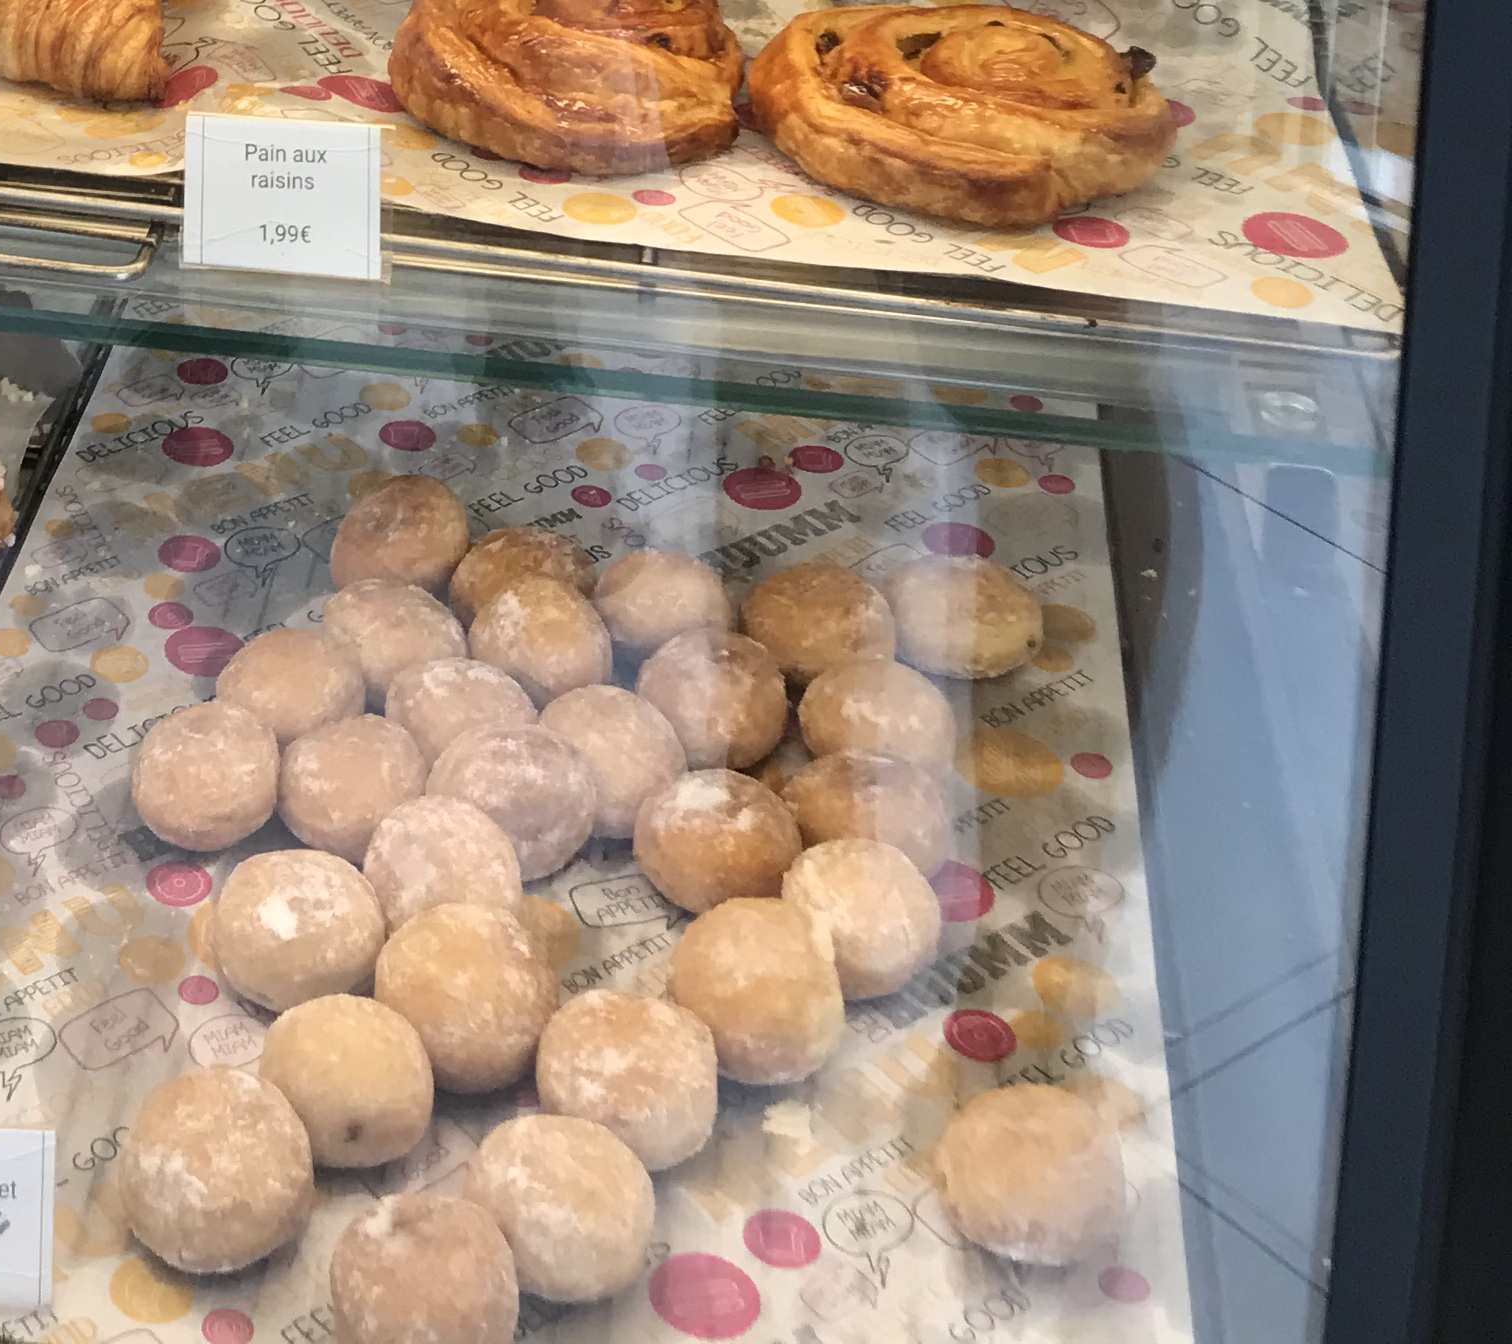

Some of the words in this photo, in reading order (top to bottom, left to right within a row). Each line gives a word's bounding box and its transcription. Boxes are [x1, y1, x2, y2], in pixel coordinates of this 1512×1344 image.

[298, 33, 353, 75] FEEL
[1249, 35, 1313, 89] FEEL
[245, 143, 287, 162] Pain
[293, 149, 328, 164] aux
[430, 152, 504, 191] GOOD
[251, 171, 315, 190] raisins
[1190, 166, 1255, 196] FEEL
[508, 190, 566, 223] FEEL
[851, 202, 935, 245] GOOD
[258, 224, 312, 245] 1,99€
[943, 243, 1008, 274] FEEL
[1208, 229, 1406, 323] DELICIOUS
[75, 410, 204, 464] DELICIOUS
[259, 424, 311, 448] FEEL
[311, 402, 372, 430] GOOD
[468, 490, 525, 518] FEEL
[524, 465, 588, 494] GOOD
[616, 456, 739, 512] DELICIOUS
[211, 515, 248, 535] BON
[250, 493, 315, 522] APPETIT
[884, 510, 932, 533] FEEL
[26, 674, 97, 709] GOOD
[980, 703, 1025, 729] BON
[1021, 669, 1094, 711] APPETIT
[981, 855, 1048, 891] FEEL
[1042, 815, 1116, 859] GOOD
[13, 880, 56, 907] BON
[601, 885, 640, 901] Bon
[561, 965, 603, 994] BON
[601, 933, 672, 977] APPETIT
[3, 967, 79, 1011] APPETIT
[1060, 1018, 1134, 1069] GOOD
